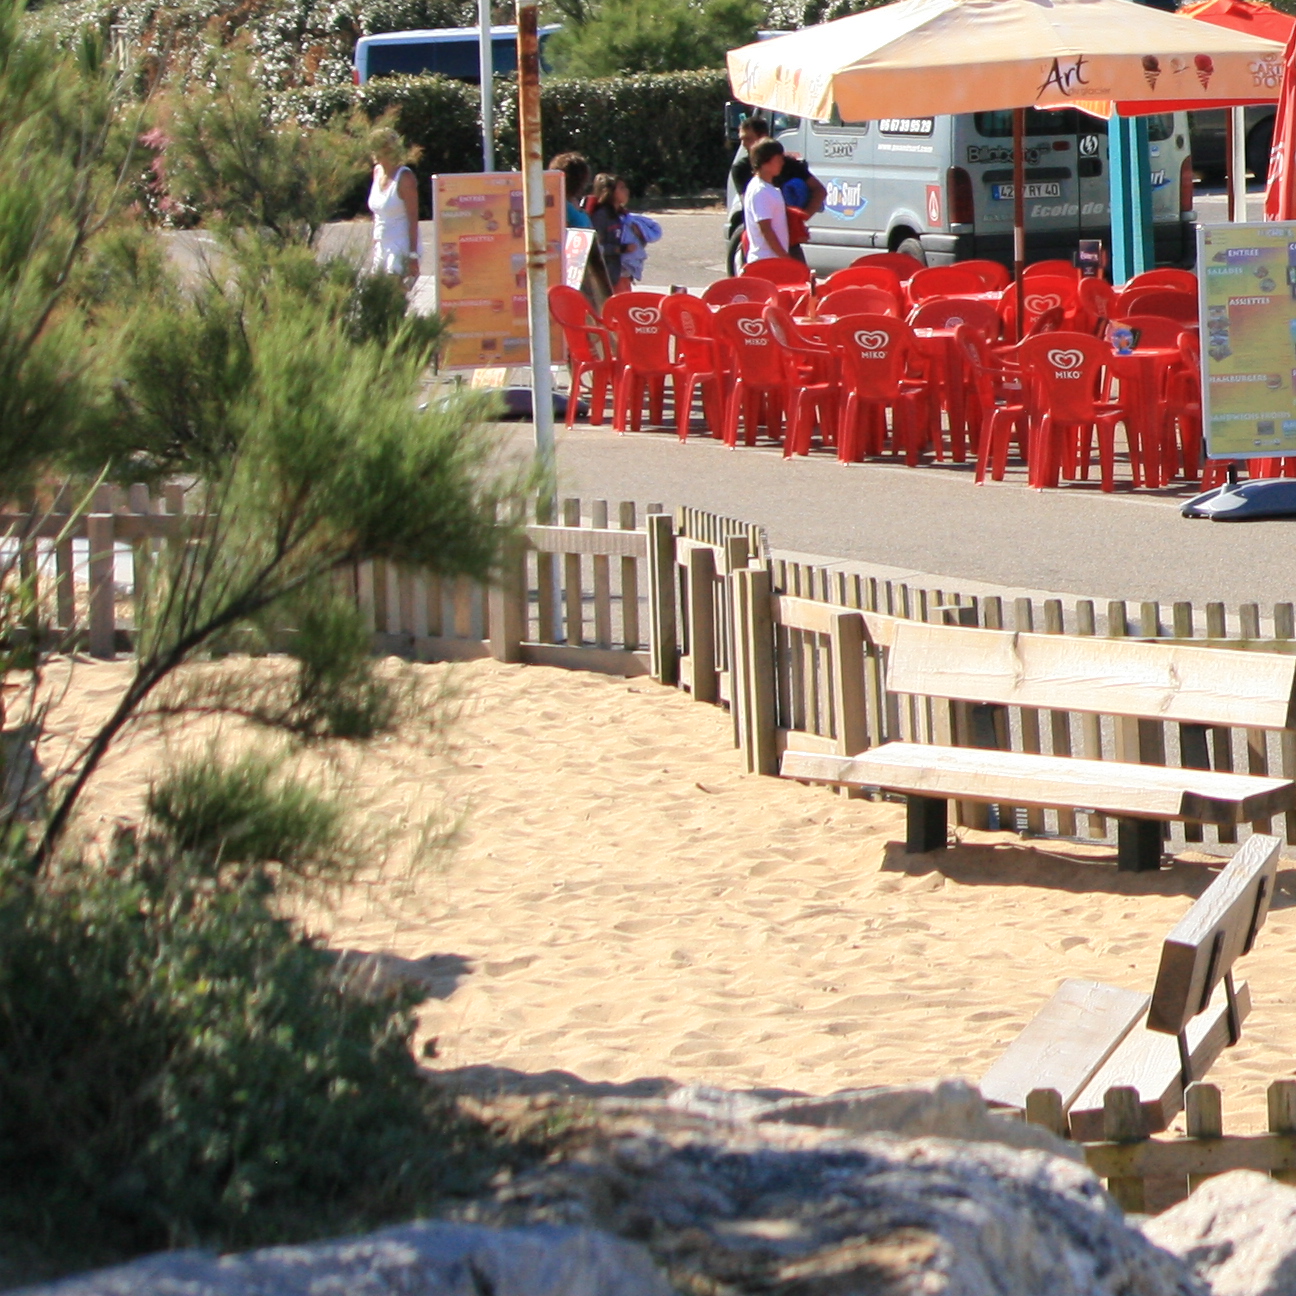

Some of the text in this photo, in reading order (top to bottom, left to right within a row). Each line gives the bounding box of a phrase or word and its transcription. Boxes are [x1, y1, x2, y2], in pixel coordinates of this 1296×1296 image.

[1249, 61, 1283, 75] CART
[1036, 54, 1089, 99] Art
[1029, 184, 1041, 198] RY
[1045, 183, 1058, 197] 40
[1031, 202, 1104, 218] Ecole de
[1229, 296, 1271, 306] ASSIETTES
[634, 326, 660, 334] MIKO
[744, 338, 768, 346] MIKO
[861, 351, 887, 359] MIKO
[1055, 371, 1081, 379] MIKO
